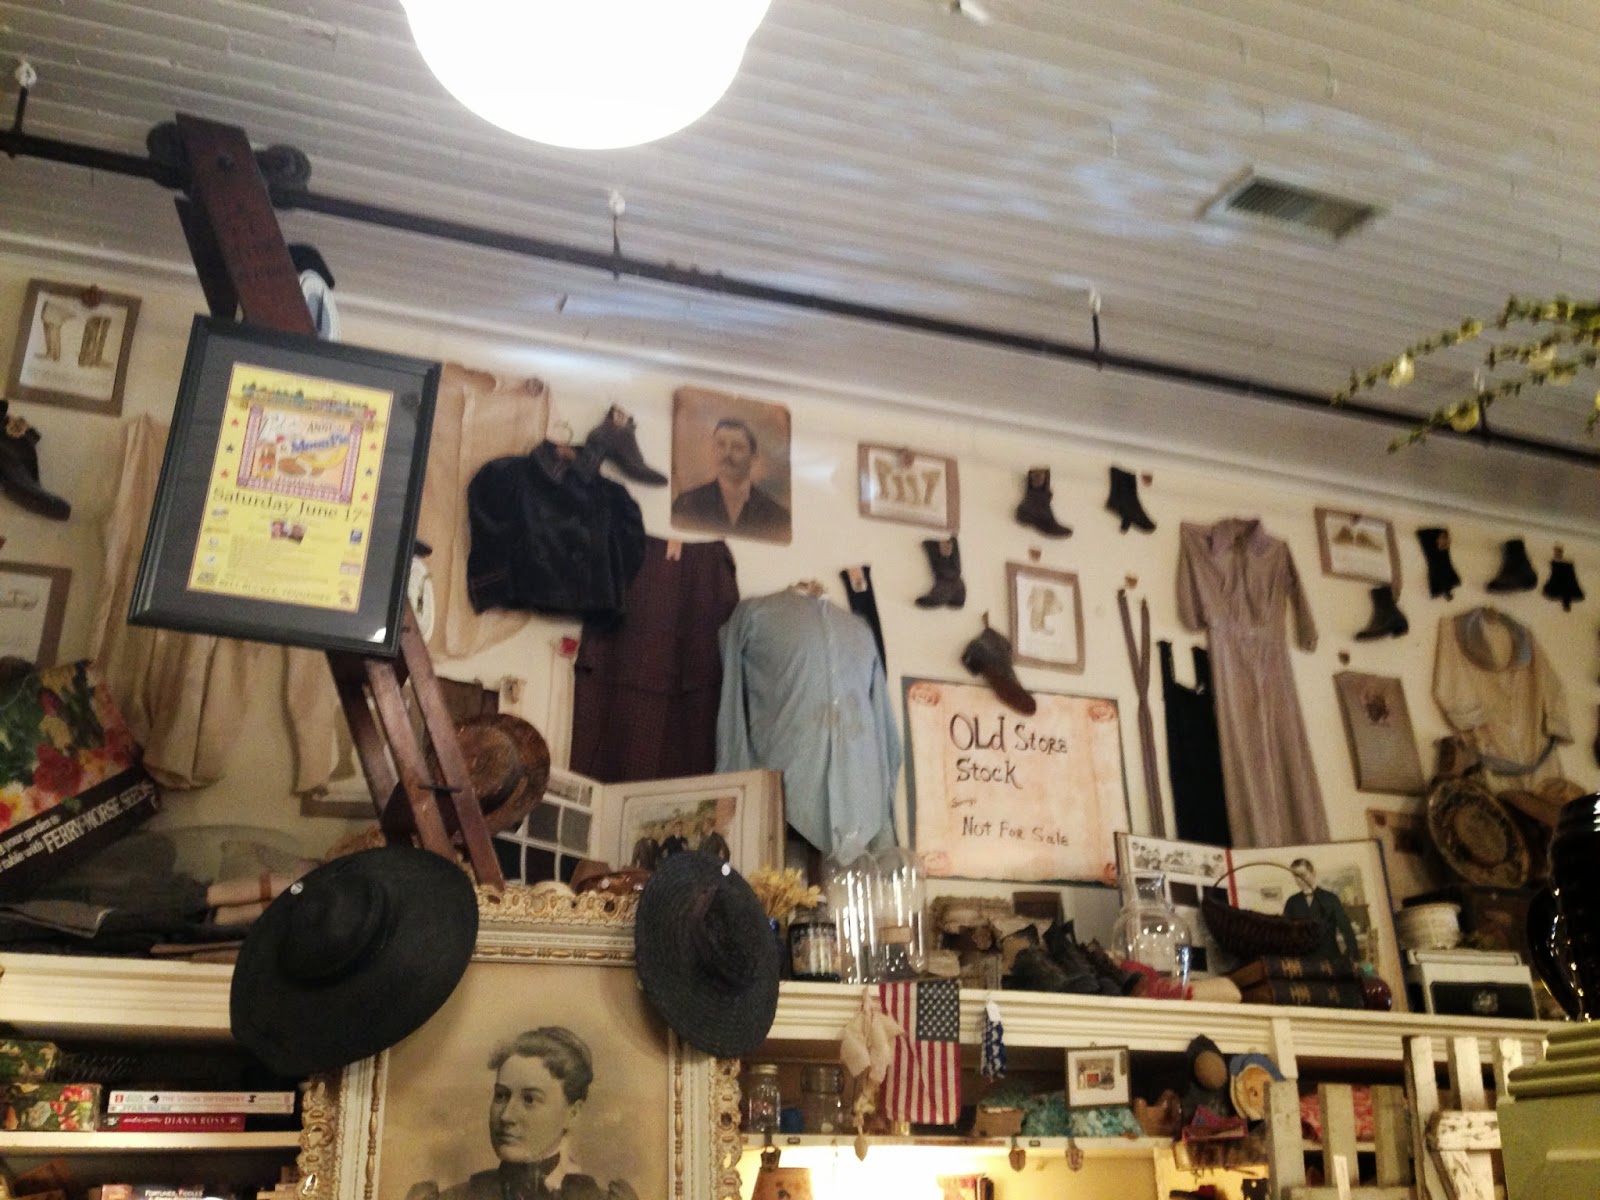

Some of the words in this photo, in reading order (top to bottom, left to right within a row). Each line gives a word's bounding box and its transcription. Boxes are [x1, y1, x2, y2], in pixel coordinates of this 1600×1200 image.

[213, 487, 293, 515] Saturday
[299, 501, 338, 518] June
[956, 757, 1023, 789] Stock
[961, 816, 992, 837] Not
[1031, 827, 1069, 847] Sale
[164, 1116, 198, 1125] DIANA
[200, 1116, 226, 1125] ROSS
